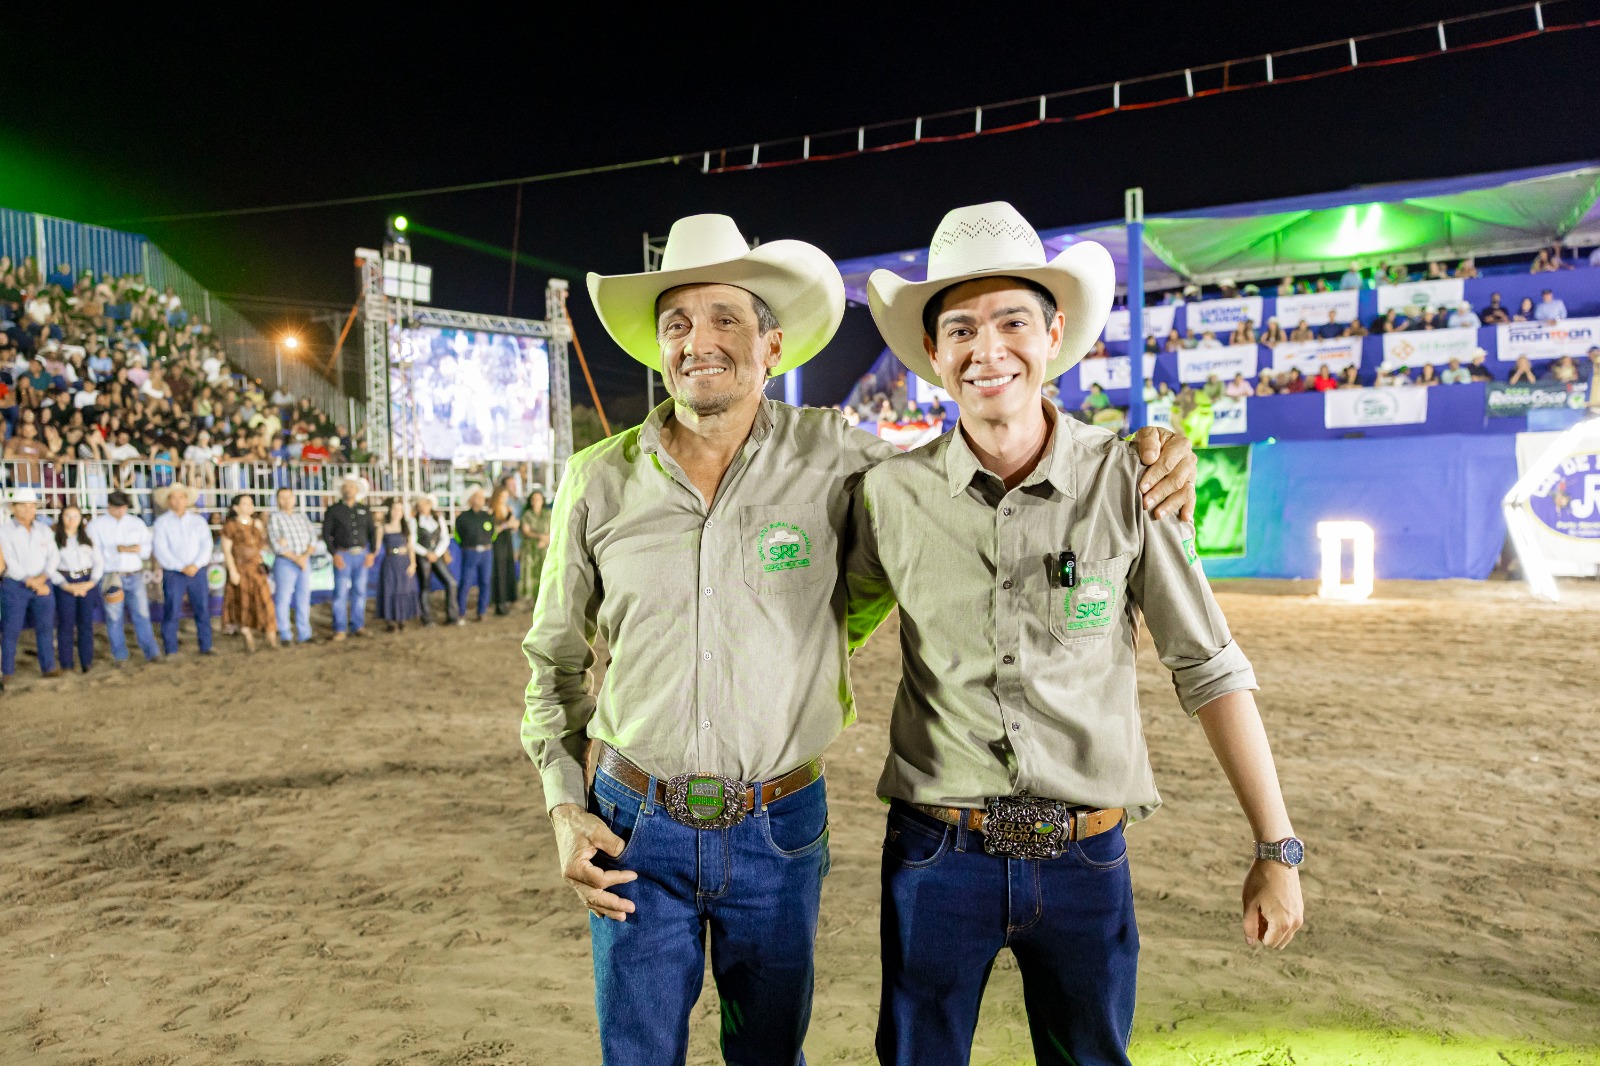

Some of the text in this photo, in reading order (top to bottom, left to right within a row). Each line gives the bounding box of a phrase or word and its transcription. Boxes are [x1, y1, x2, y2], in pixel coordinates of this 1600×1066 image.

[769, 543, 800, 561] SRP
[1316, 520, 1375, 600] D
[1076, 601, 1107, 619] SRP
[996, 821, 1034, 834] CELSO
[1002, 832, 1049, 843] MORAIS
